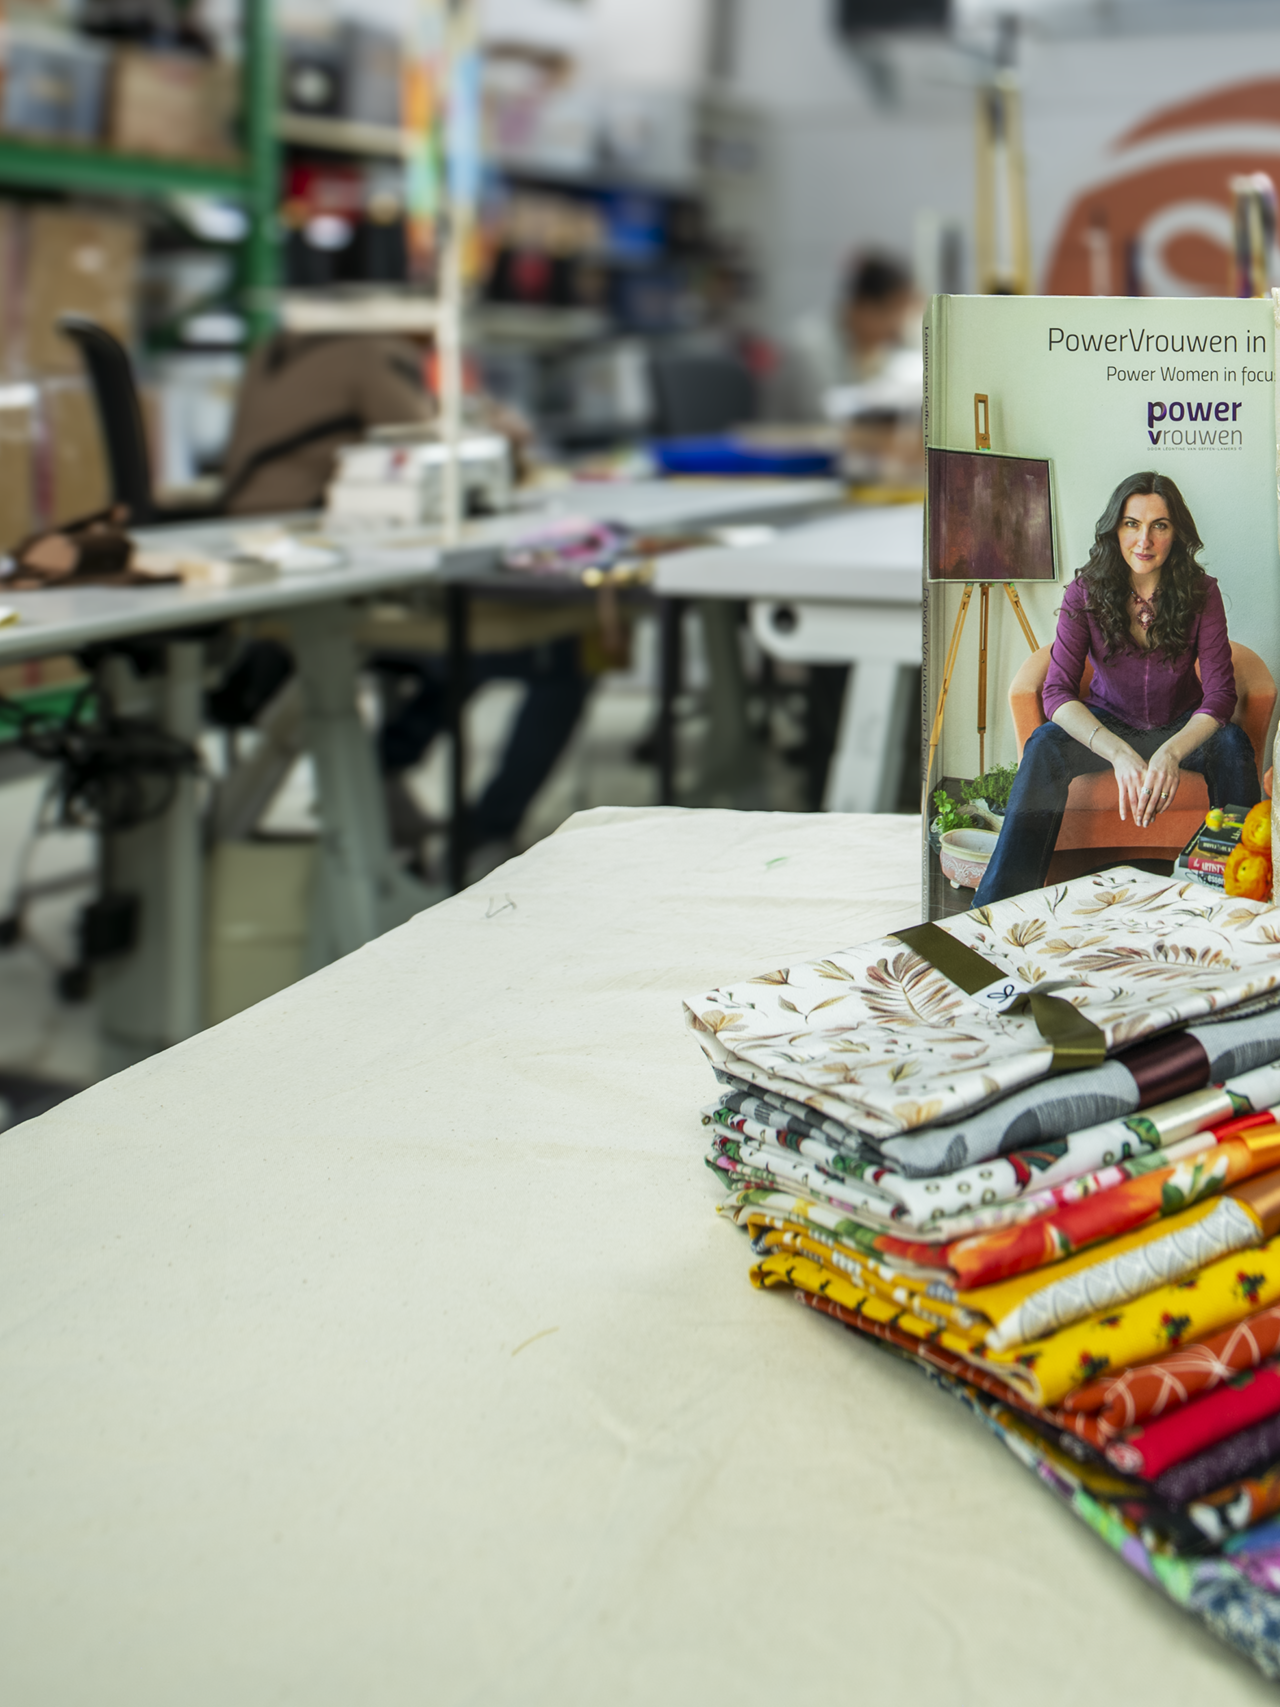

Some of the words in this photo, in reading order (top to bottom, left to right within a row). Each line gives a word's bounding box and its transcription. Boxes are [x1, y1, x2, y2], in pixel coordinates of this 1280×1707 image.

[1048, 327, 1237, 353] PowerVrouwen
[1246, 329, 1266, 353] in
[1106, 365, 1156, 382] Power
[1160, 366, 1219, 382] Women
[1223, 366, 1237, 382] in
[1241, 365, 1276, 386] focu
[1147, 401, 1243, 429] power
[1147, 429, 1243, 446] vrouwen
